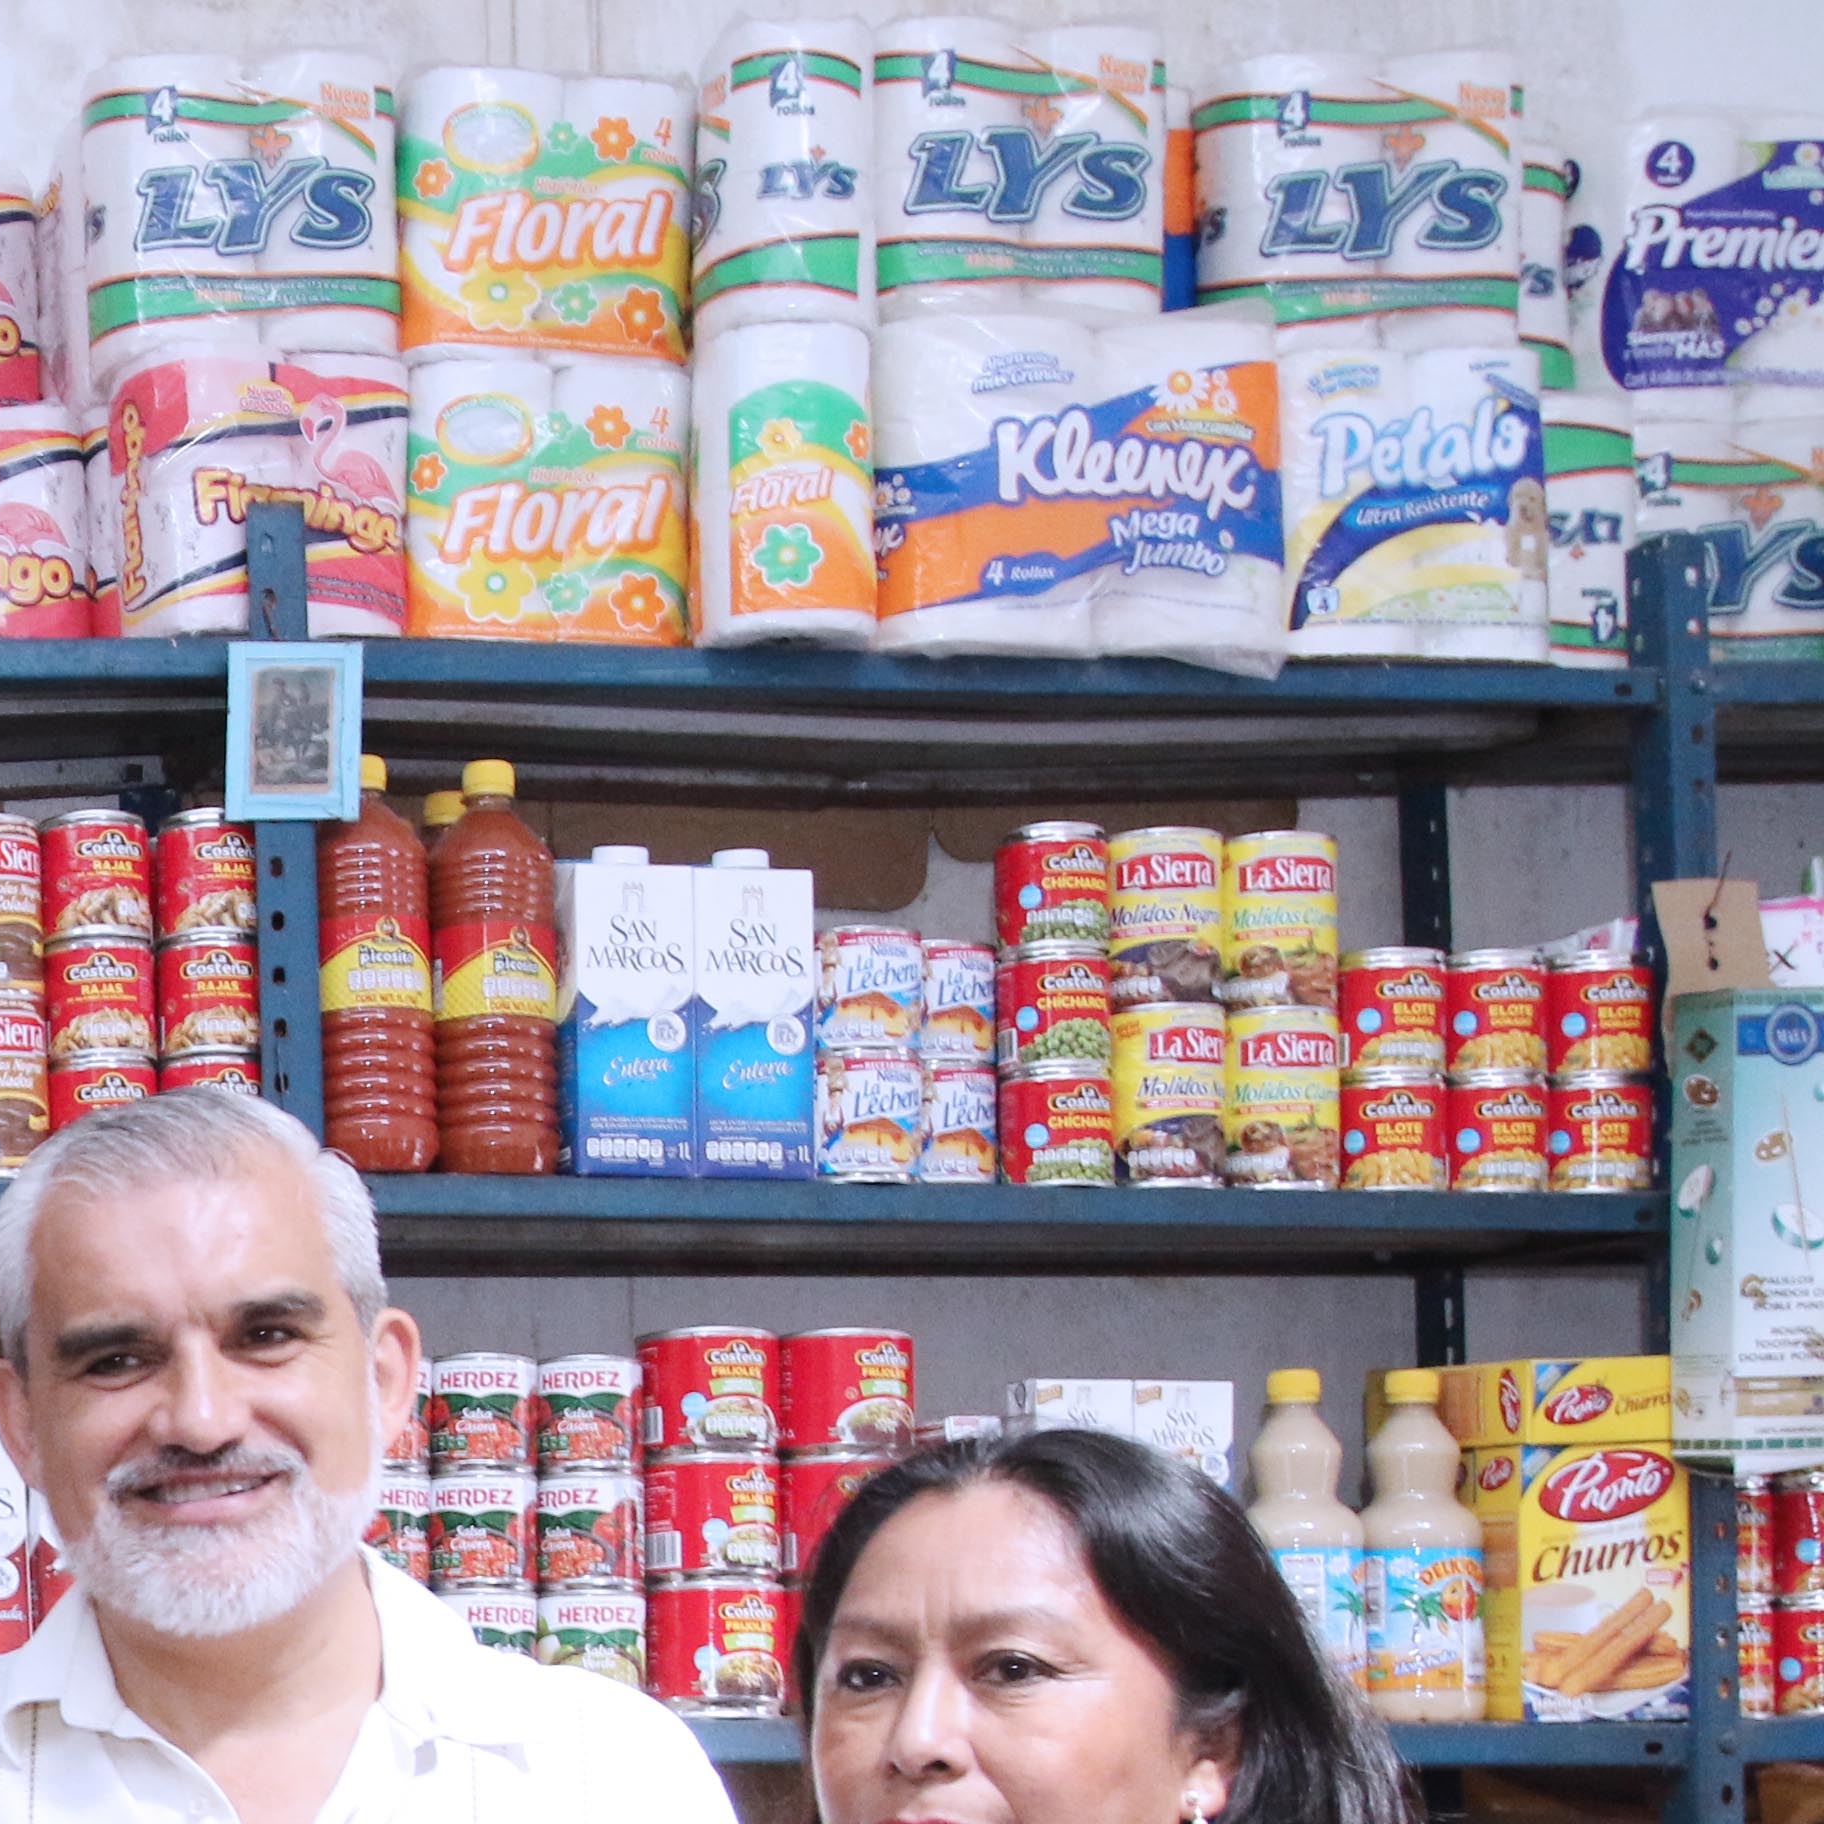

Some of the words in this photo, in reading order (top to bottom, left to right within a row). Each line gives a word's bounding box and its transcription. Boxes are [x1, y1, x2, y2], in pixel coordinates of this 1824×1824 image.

[902, 124, 1153, 224] LYS
[1656, 144, 1682, 175] 4
[756, 159, 859, 202] LYS
[133, 154, 377, 256] LYS
[1259, 158, 1509, 262] LYS
[446, 188, 676, 275] Floral
[1624, 204, 1824, 275] Premie
[648, 407, 670, 434] 4
[993, 406, 1256, 520] Kleenex
[1311, 399, 1530, 497] Pétalo
[122, 397, 147, 614] Flamingo
[729, 467, 836, 516] Floral
[441, 472, 674, 567] Floral
[1356, 505, 1402, 526] Ultra
[1406, 491, 1490, 519] Resistente
[1110, 511, 1200, 548] Mega
[986, 560, 1003, 586] 4
[1011, 565, 1055, 580] Rollos
[1124, 540, 1226, 576] Jumbo
[1318, 594, 1329, 611] 4
[1123, 866, 1146, 887] La
[1150, 855, 1213, 885] Sierra
[609, 914, 657, 945] SAN
[1111, 903, 1176, 926] Molidos
[70, 966, 134, 978] Costeña
[587, 943, 686, 975] MARCOS
[857, 955, 874, 971] La
[80, 983, 124, 996] RAJAS
[197, 981, 239, 992] RAJAS
[1478, 984, 1542, 999] Costeña
[1393, 1002, 1436, 1016] ELOTE
[603, 1056, 675, 1087] Entera
[1376, 1123, 1423, 1135] ELOTE
[440, 1371, 518, 1390] HERDEZ
[461, 1407, 492, 1419] Salsa
[1551, 1386, 1610, 1424] Pronto
[455, 1421, 497, 1434] Casera
[436, 1489, 512, 1507] HERDEZ
[1549, 1451, 1666, 1520] Pronto
[1532, 1528, 1682, 1583] Churros
[558, 1607, 637, 1623] HERDEZ
